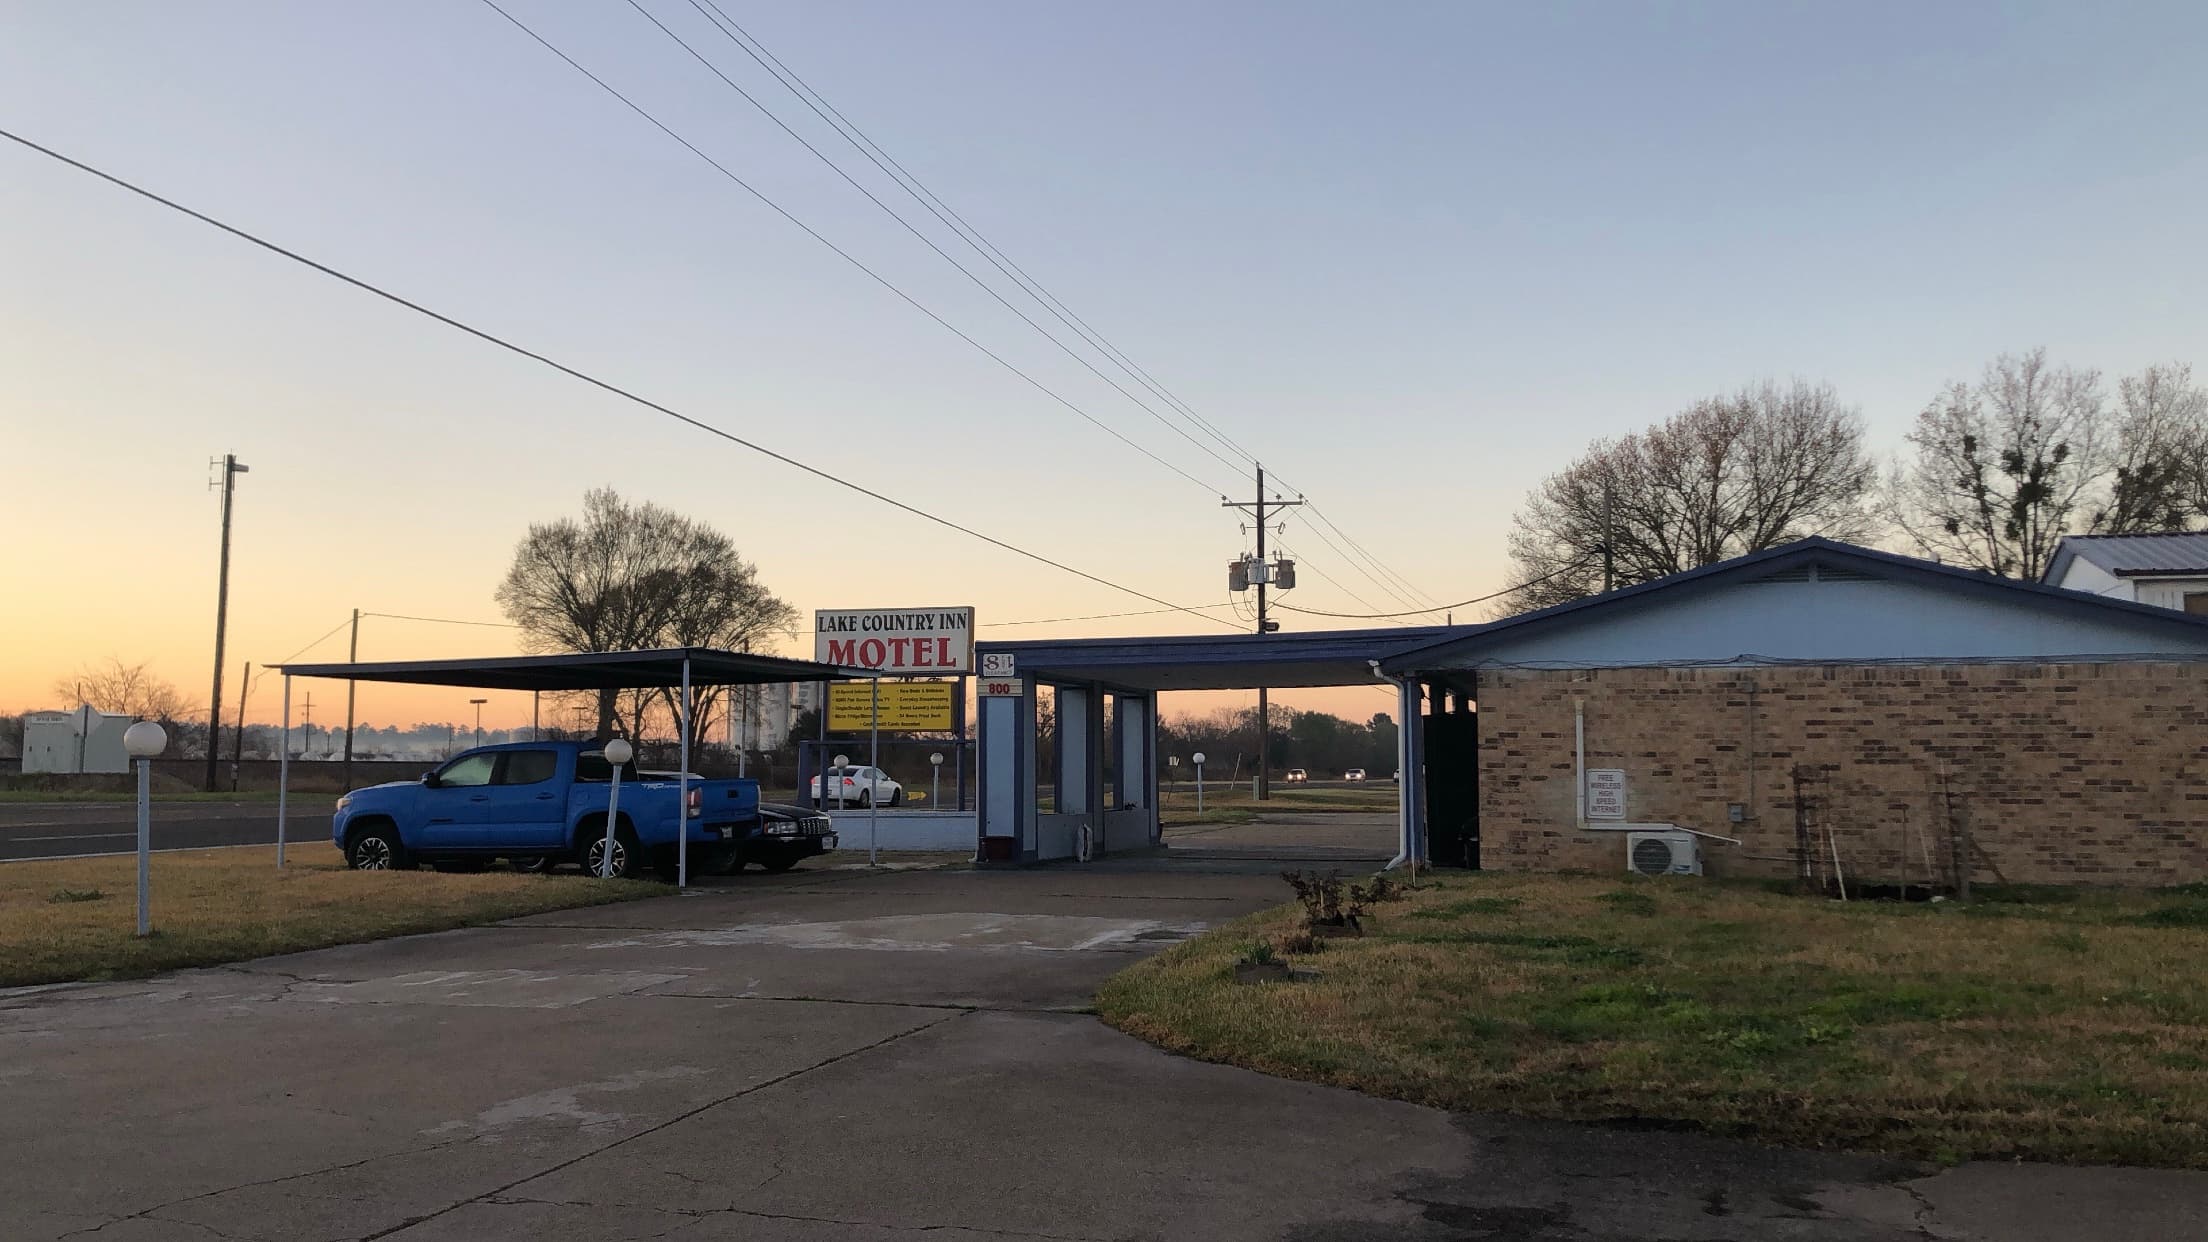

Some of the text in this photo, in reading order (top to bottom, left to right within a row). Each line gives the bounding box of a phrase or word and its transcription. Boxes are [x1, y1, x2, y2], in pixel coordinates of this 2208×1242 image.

[819, 613, 967, 632] LAKE COUNTRY INN
[828, 638, 956, 667] MOTEL
[989, 683, 1010, 694] 800
